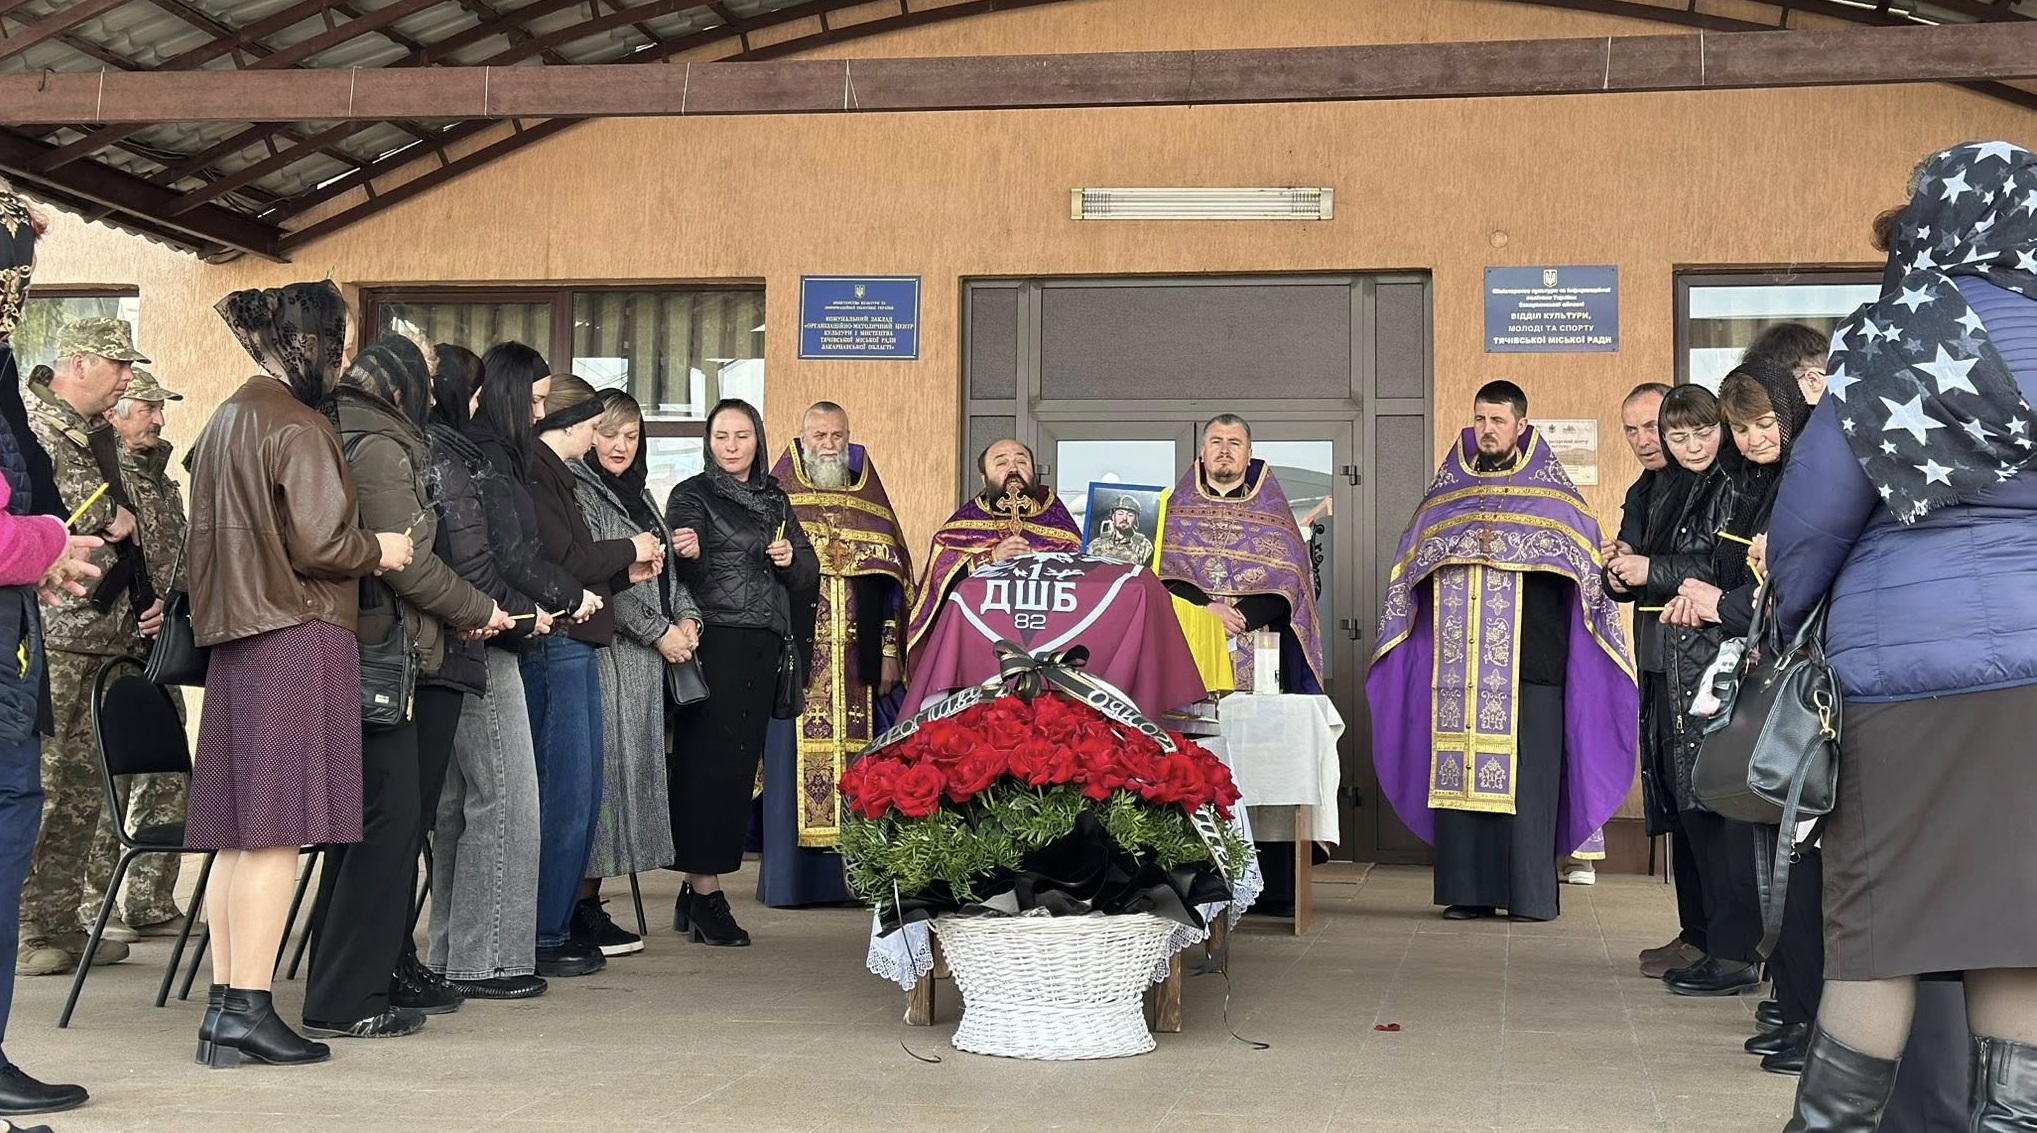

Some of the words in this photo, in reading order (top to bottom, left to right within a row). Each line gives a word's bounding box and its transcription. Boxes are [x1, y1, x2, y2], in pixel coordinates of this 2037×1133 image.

[1543, 312, 1592, 320] КУЛЬТУРИ,
[1493, 336, 1546, 344] ТЯЧІВСЬКОЇ
[1548, 336, 1585, 344] МІСЬКОЇ
[980, 580, 1078, 614] ДШБ
[1014, 613, 1047, 630] 82
